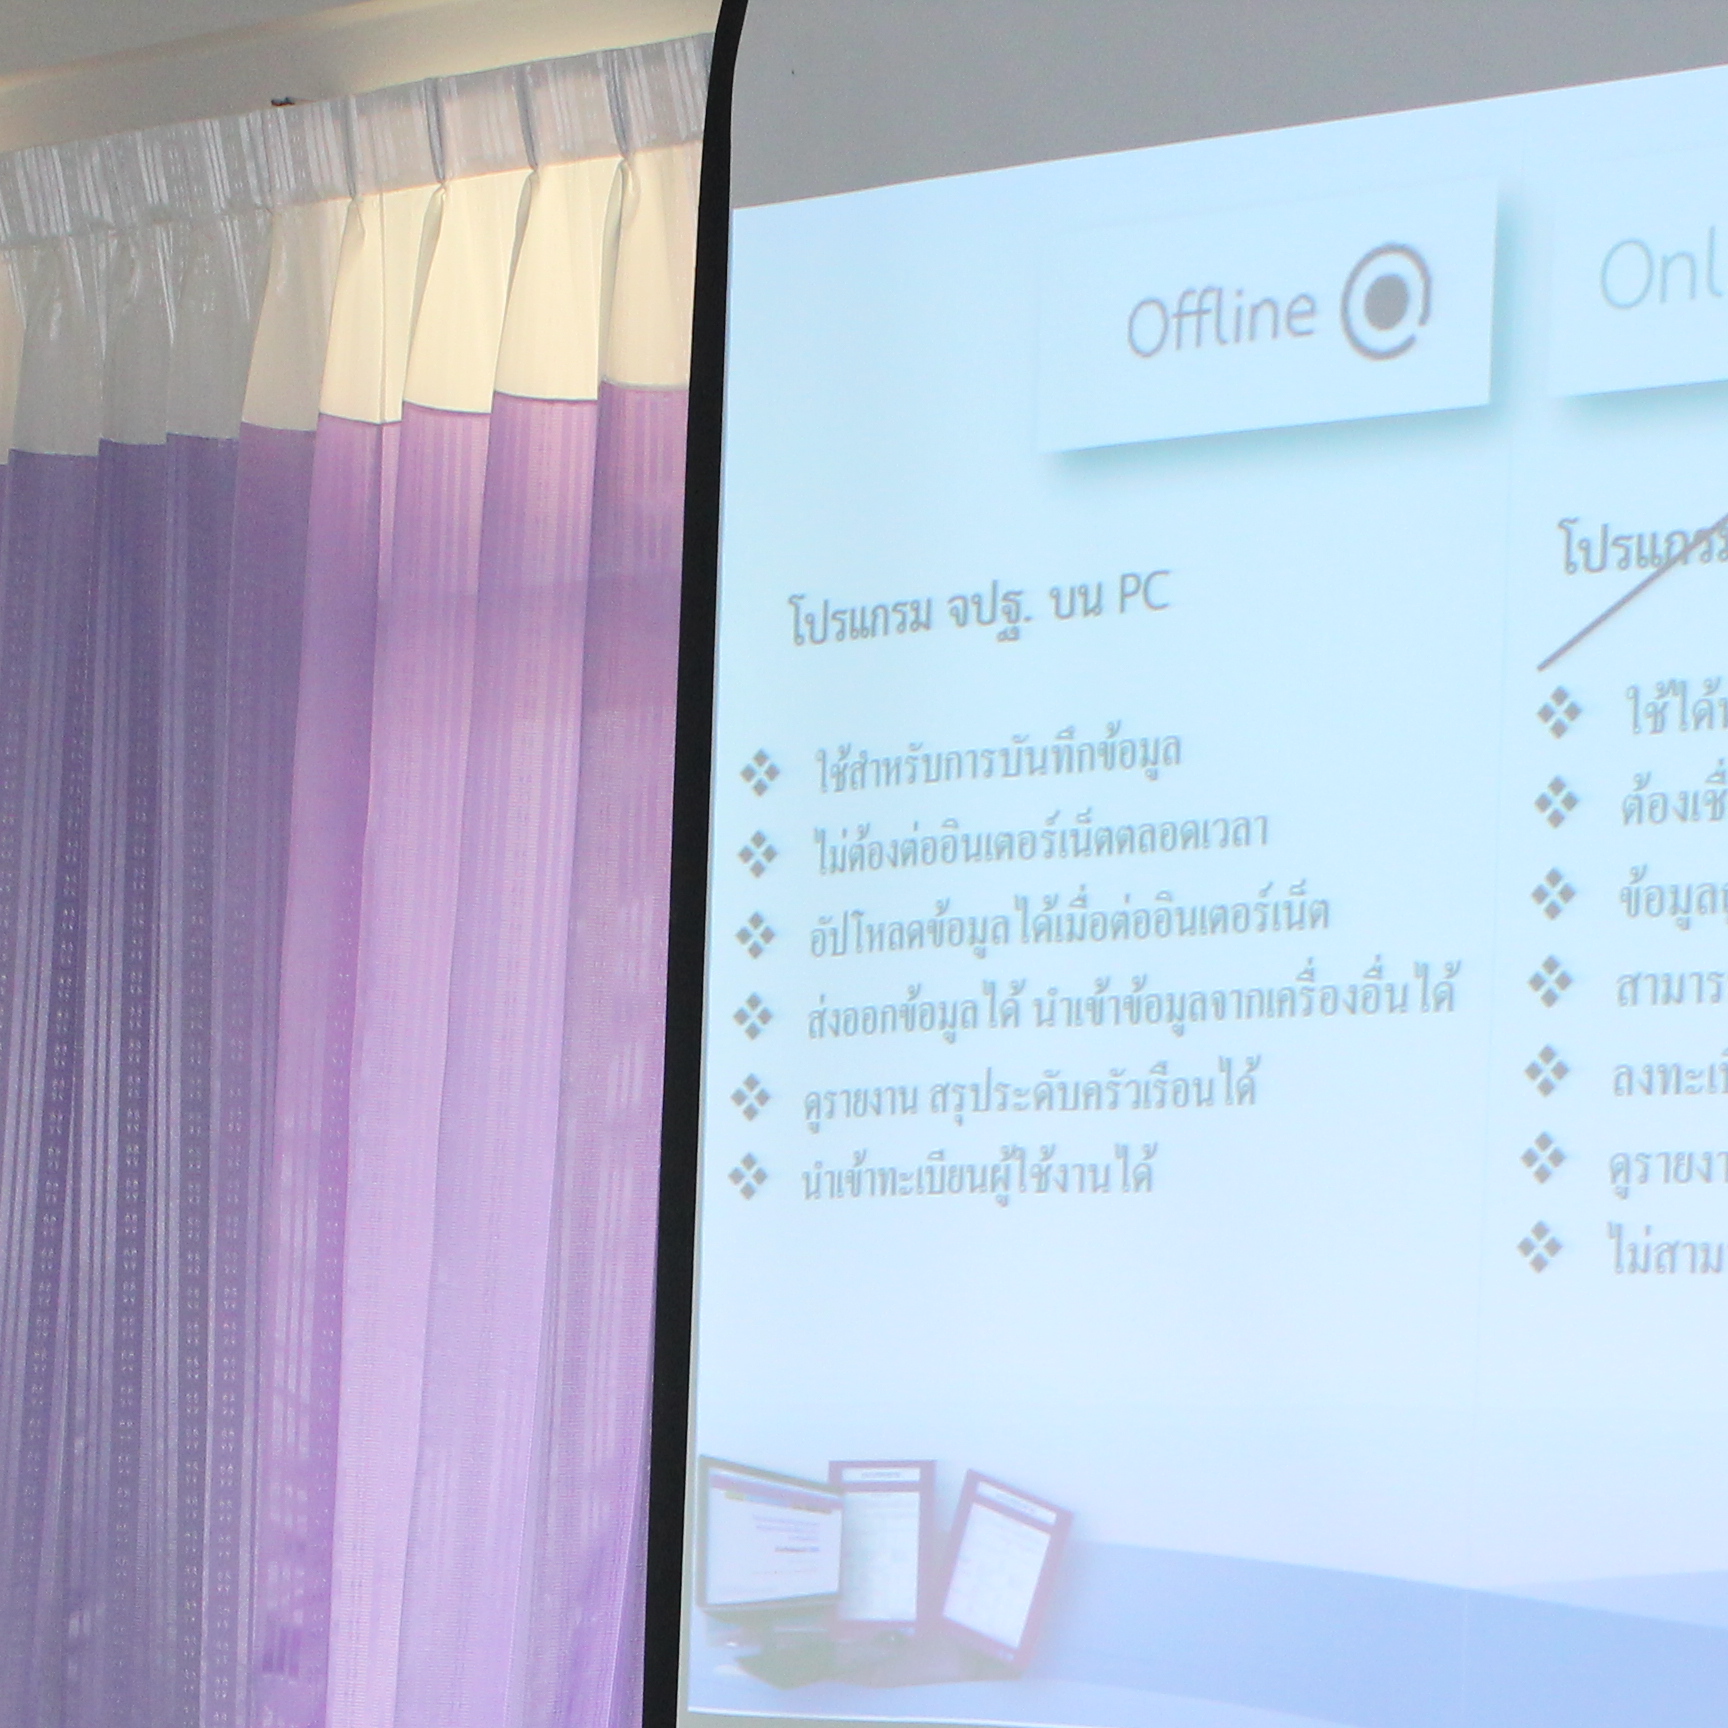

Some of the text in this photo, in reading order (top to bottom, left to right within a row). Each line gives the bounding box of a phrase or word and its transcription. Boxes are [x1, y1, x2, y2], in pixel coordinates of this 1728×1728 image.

[1127, 284, 1318, 358] Offline
[786, 570, 1171, 647] โปรแกรม จปฐ. บน PC
[815, 720, 1181, 795] ใช้สำหรับการบันทึกข้อมูล
[802, 1079, 918, 1133] ดูรายงาน
